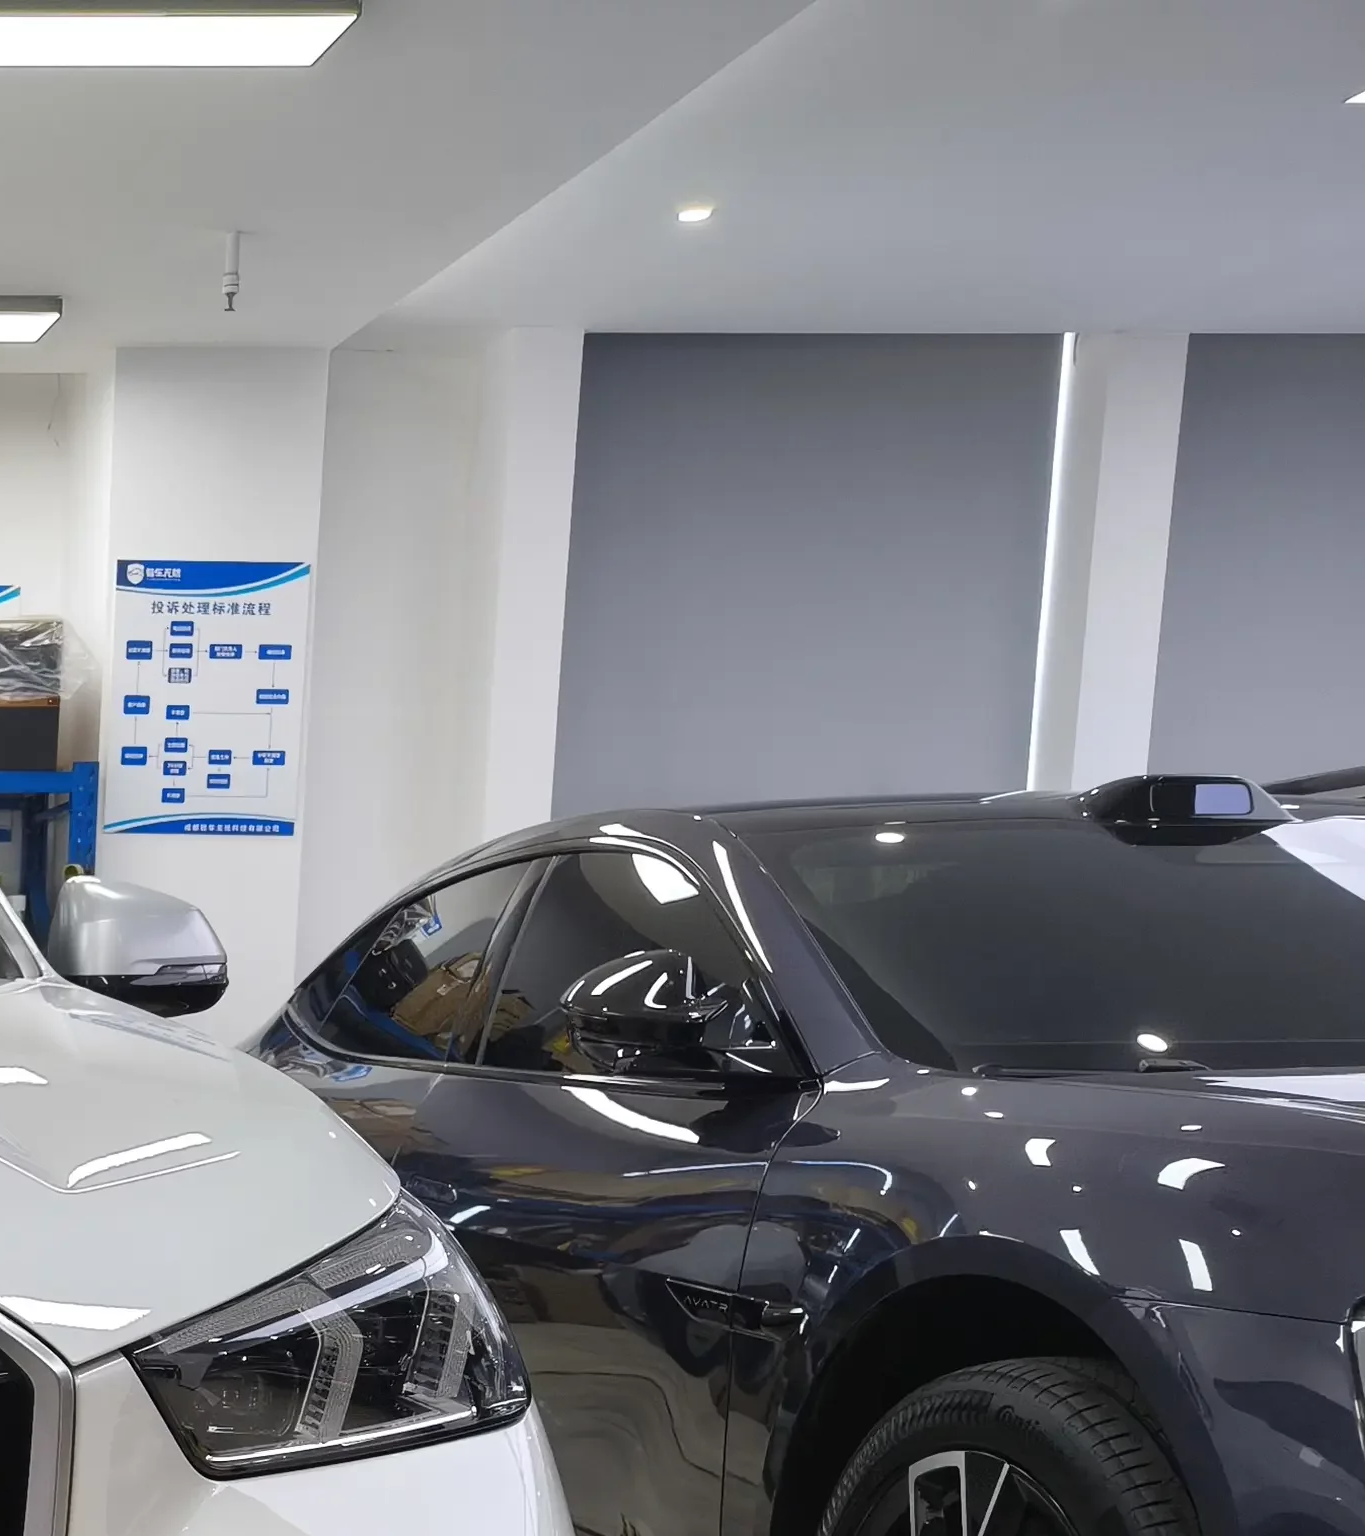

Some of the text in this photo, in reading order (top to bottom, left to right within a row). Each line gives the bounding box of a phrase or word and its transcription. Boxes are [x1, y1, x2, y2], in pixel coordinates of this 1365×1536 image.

[151, 600, 271, 616] 投诉处理标准流程
